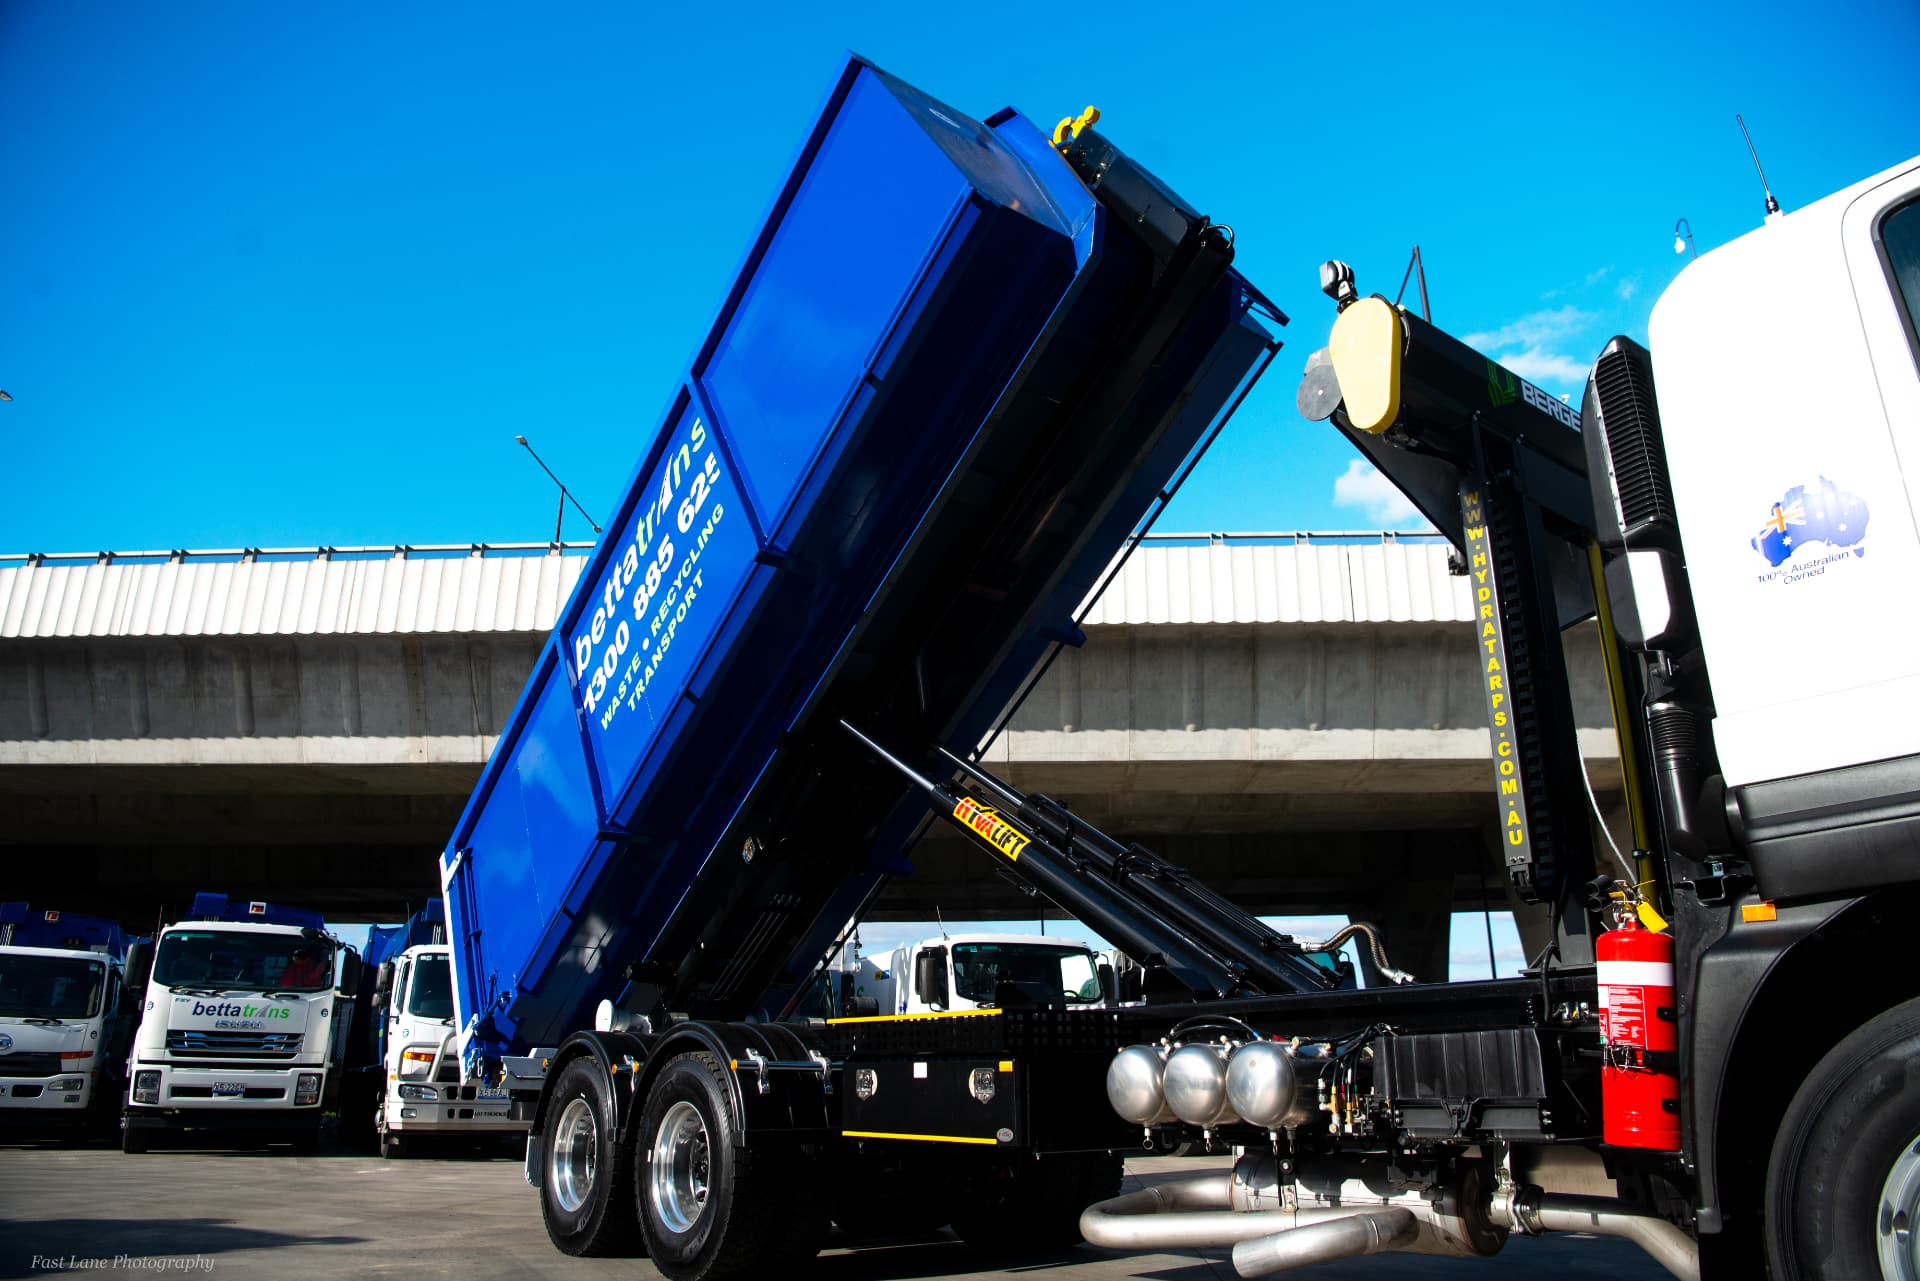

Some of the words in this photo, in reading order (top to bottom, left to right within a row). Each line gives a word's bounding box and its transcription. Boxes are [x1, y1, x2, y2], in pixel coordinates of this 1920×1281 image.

[584, 620, 629, 714] 1300
[633, 533, 674, 621] 885
[678, 451, 721, 533] 625
[601, 652, 642, 730] WASTE
[651, 504, 724, 638] RECYCLING
[1758, 570, 1788, 583] 100%
[1791, 551, 1850, 574] Australian
[1783, 566, 1825, 585] Owned
[627, 568, 703, 711] TRANSPORT
